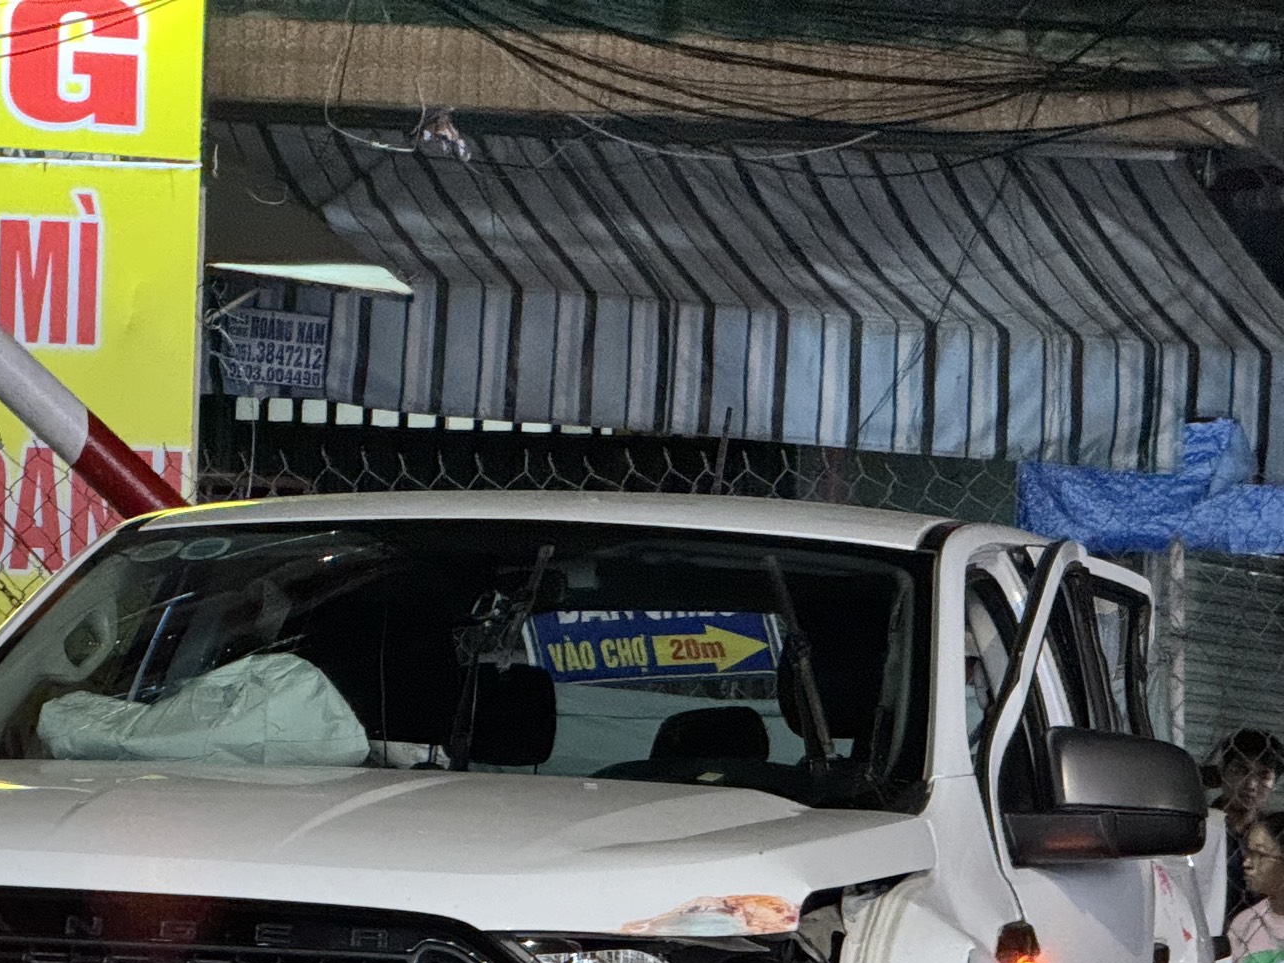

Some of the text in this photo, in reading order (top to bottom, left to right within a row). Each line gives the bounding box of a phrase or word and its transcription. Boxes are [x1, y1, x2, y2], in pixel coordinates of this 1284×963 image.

[547, 634, 727, 673] VÀO CHỢ 20m
